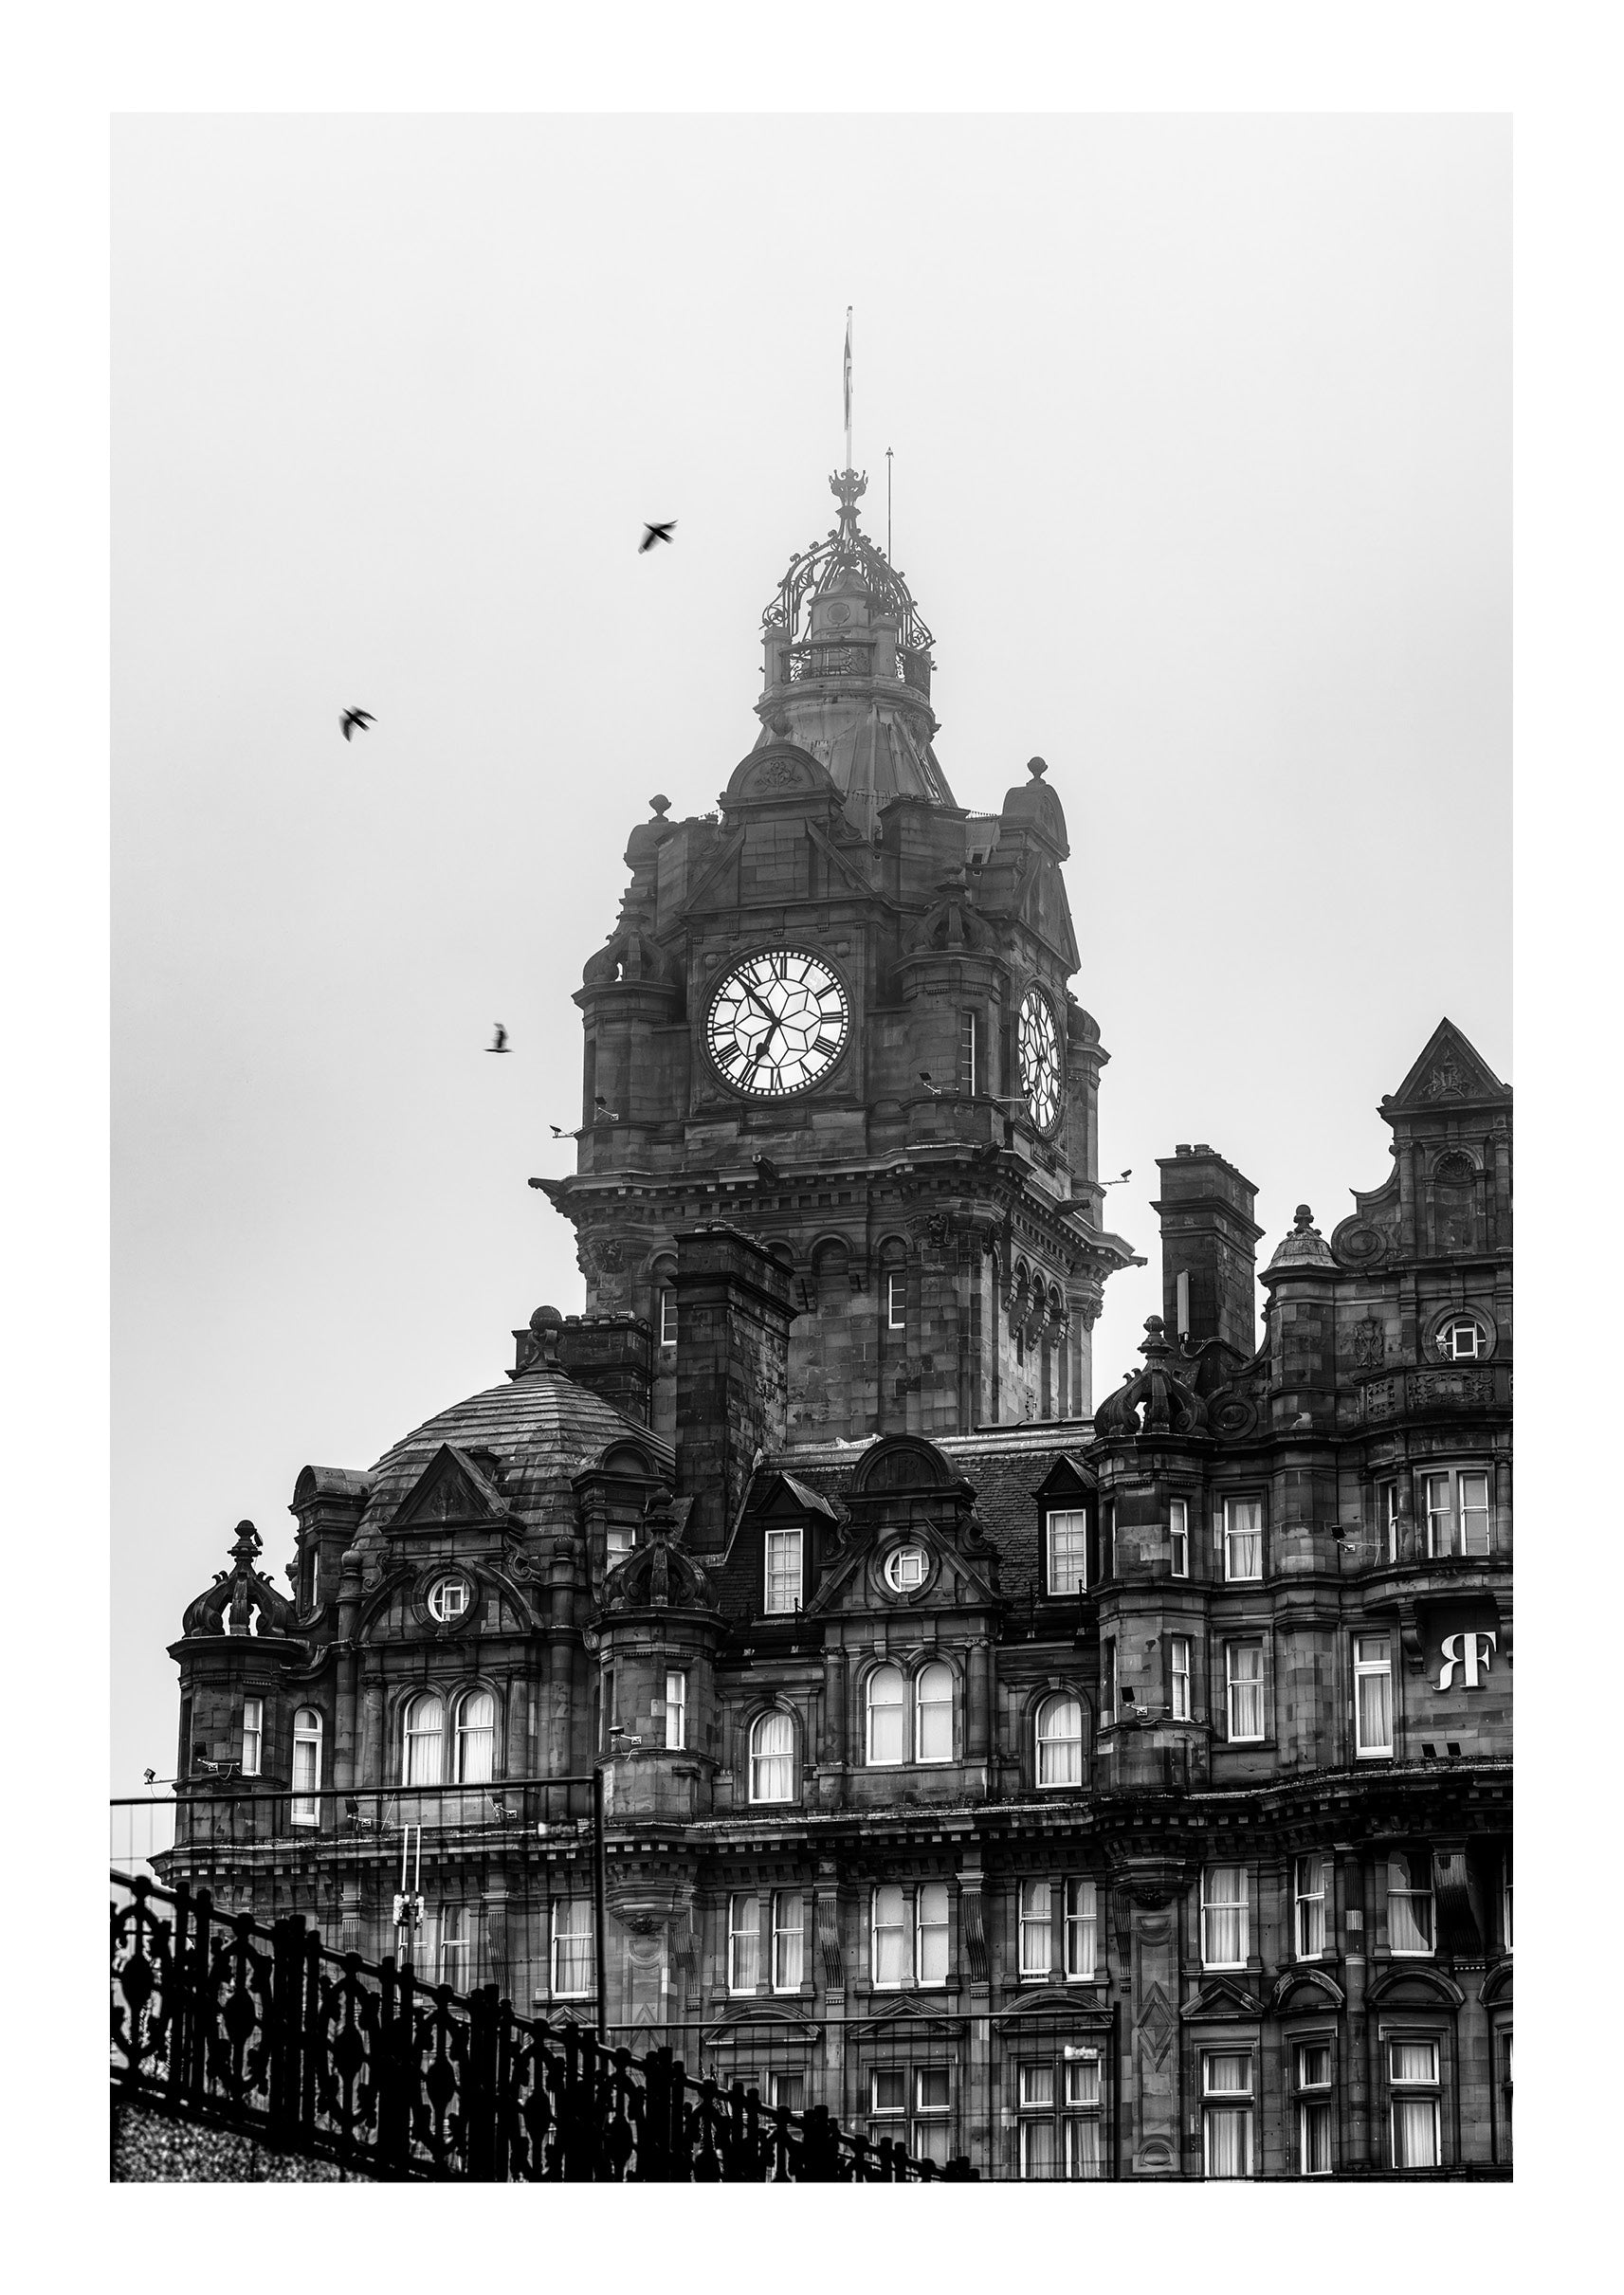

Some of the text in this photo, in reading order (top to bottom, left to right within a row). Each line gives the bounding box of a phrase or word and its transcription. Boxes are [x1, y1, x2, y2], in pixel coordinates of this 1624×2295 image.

[769, 957, 787, 980] XII
[799, 961, 812, 983] I
[719, 992, 742, 1010] X
[814, 983, 837, 1000] II
[821, 1011, 843, 1024] III
[798, 1059, 813, 1081] V
